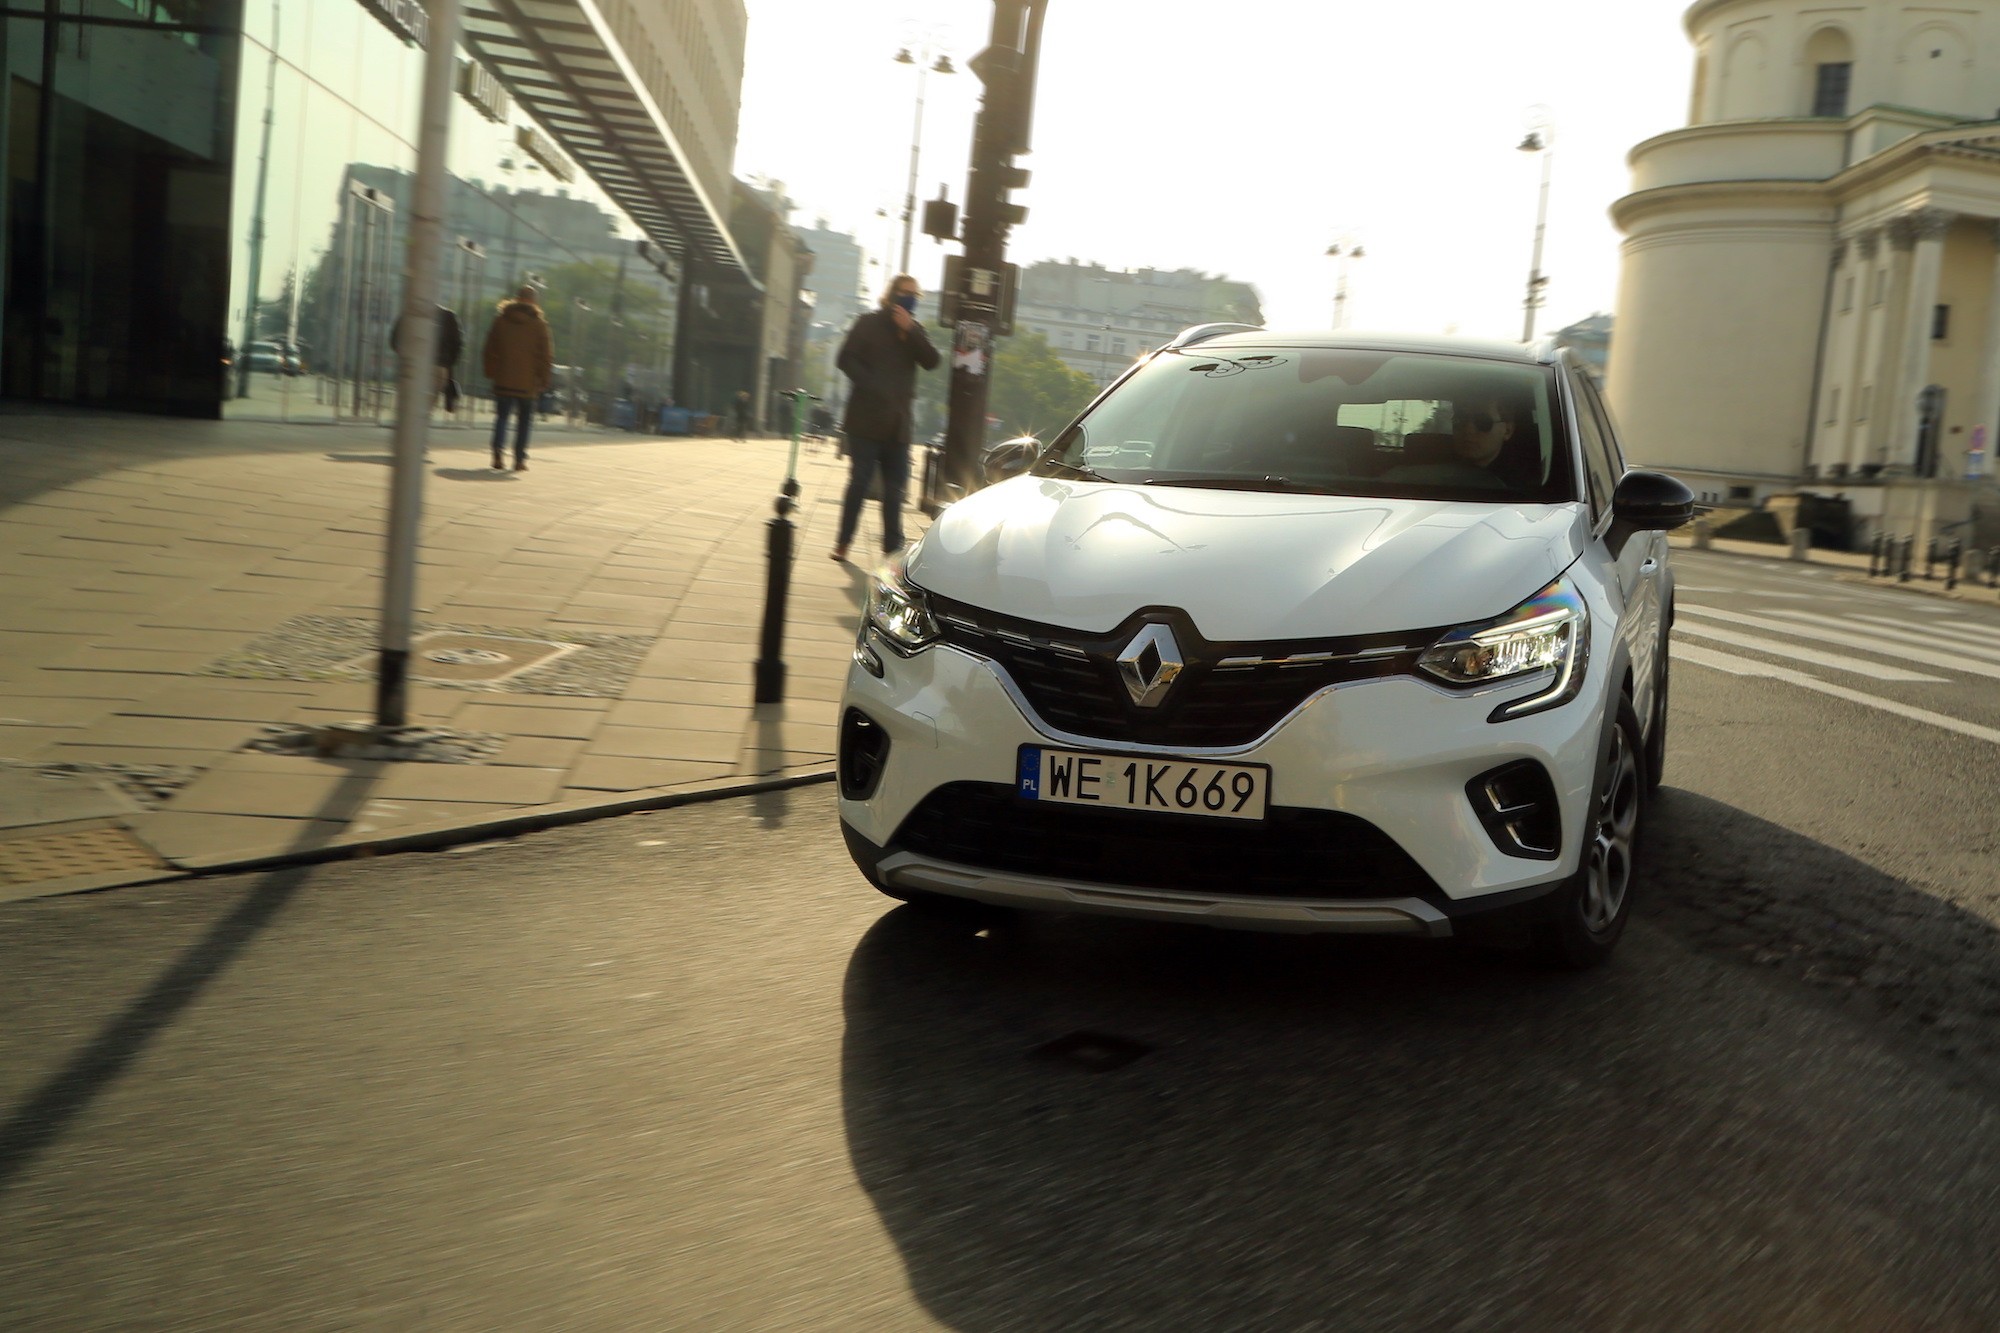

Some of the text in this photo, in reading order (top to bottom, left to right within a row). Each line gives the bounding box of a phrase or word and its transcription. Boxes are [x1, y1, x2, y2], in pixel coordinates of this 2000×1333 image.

[1022, 778, 1037, 791] PL
[1050, 755, 1254, 812] WE 1K669
